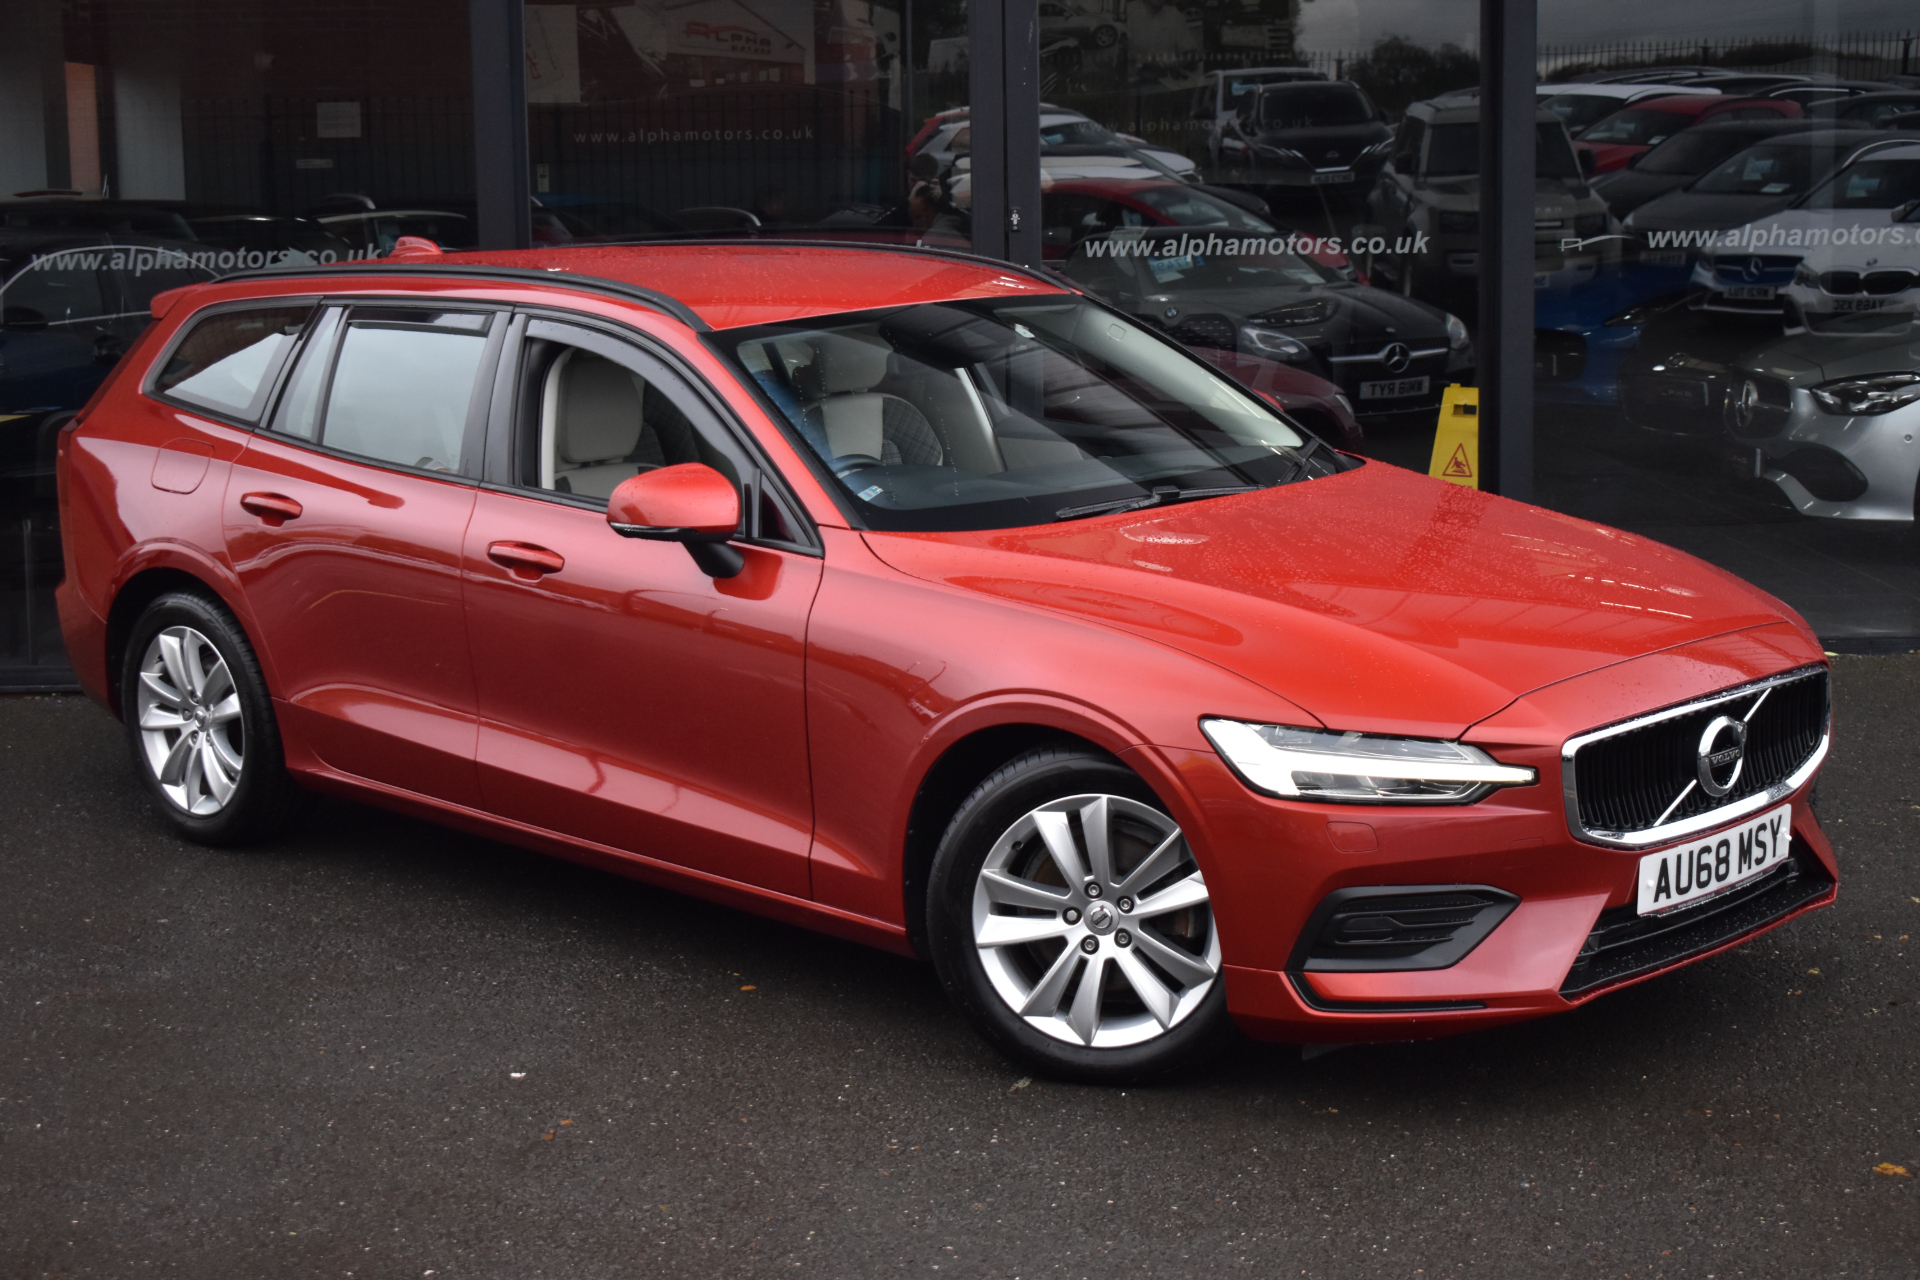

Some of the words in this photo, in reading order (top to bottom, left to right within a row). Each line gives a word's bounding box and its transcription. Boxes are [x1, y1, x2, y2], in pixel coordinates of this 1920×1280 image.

[574, 126, 814, 145] www.alphamotors.co.uk
[1085, 231, 1430, 262] www.alphamotors.co.uk
[1711, 749, 1740, 765] VOLVO
[1653, 838, 1733, 903] AU68
[1738, 814, 1783, 875] MSY
